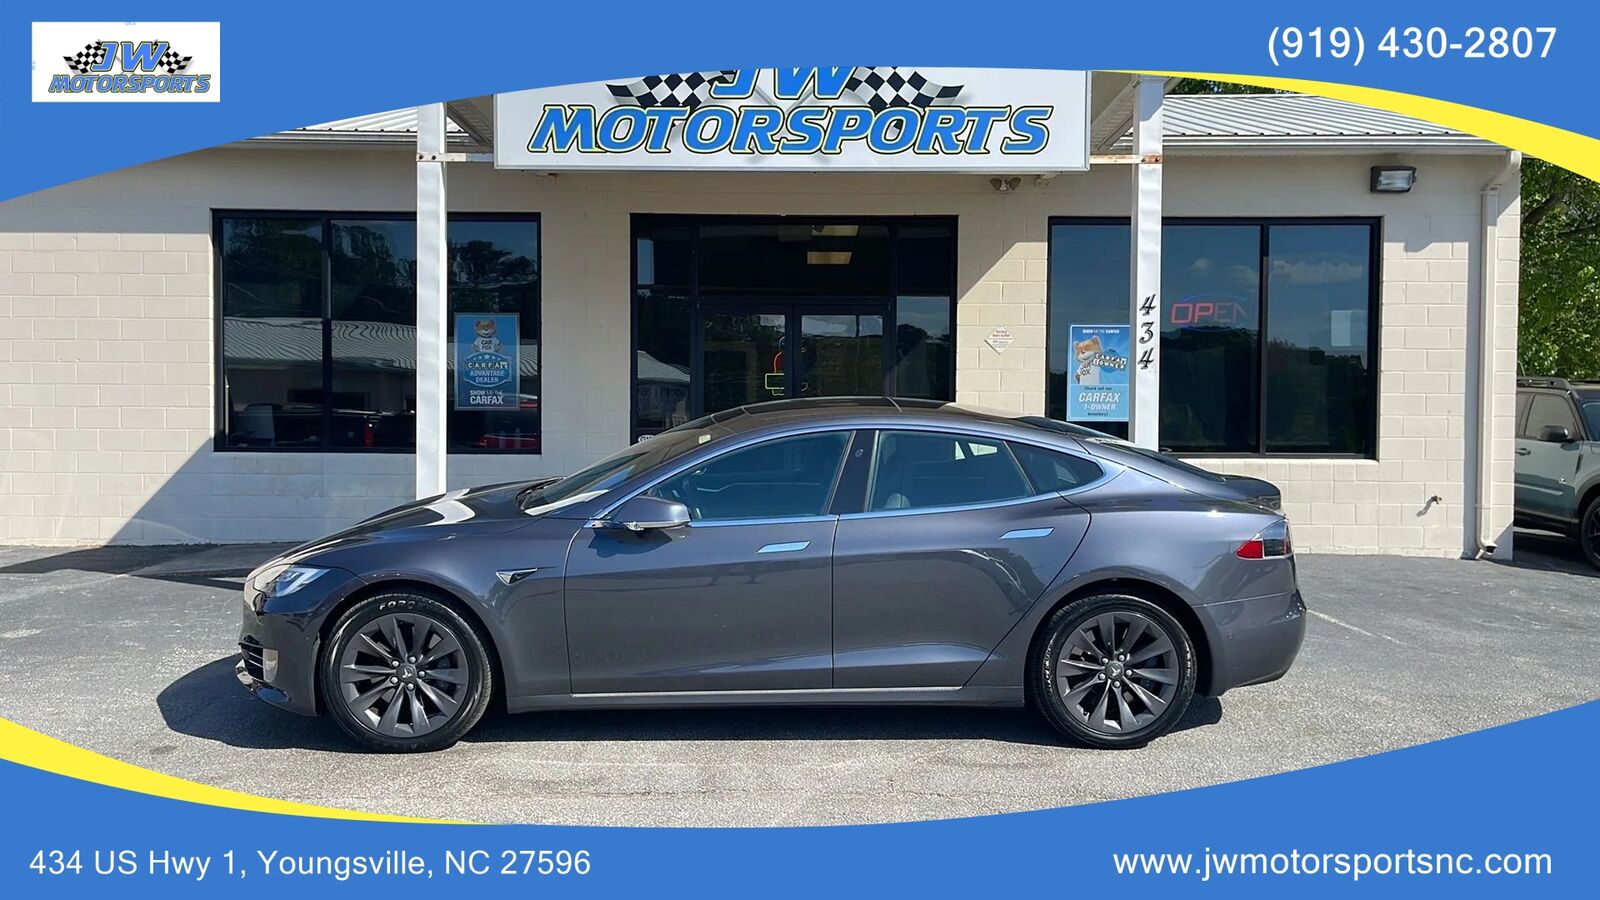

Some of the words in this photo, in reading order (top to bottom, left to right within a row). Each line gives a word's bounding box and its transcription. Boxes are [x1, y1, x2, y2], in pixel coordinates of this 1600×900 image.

[527, 103, 1056, 156] MOTORSPORTS
[1169, 302, 1248, 324] OPEN
[470, 395, 504, 404] CARFAX
[1079, 392, 1121, 402] CARFAX
[1084, 403, 1116, 411] 1-OWNER
